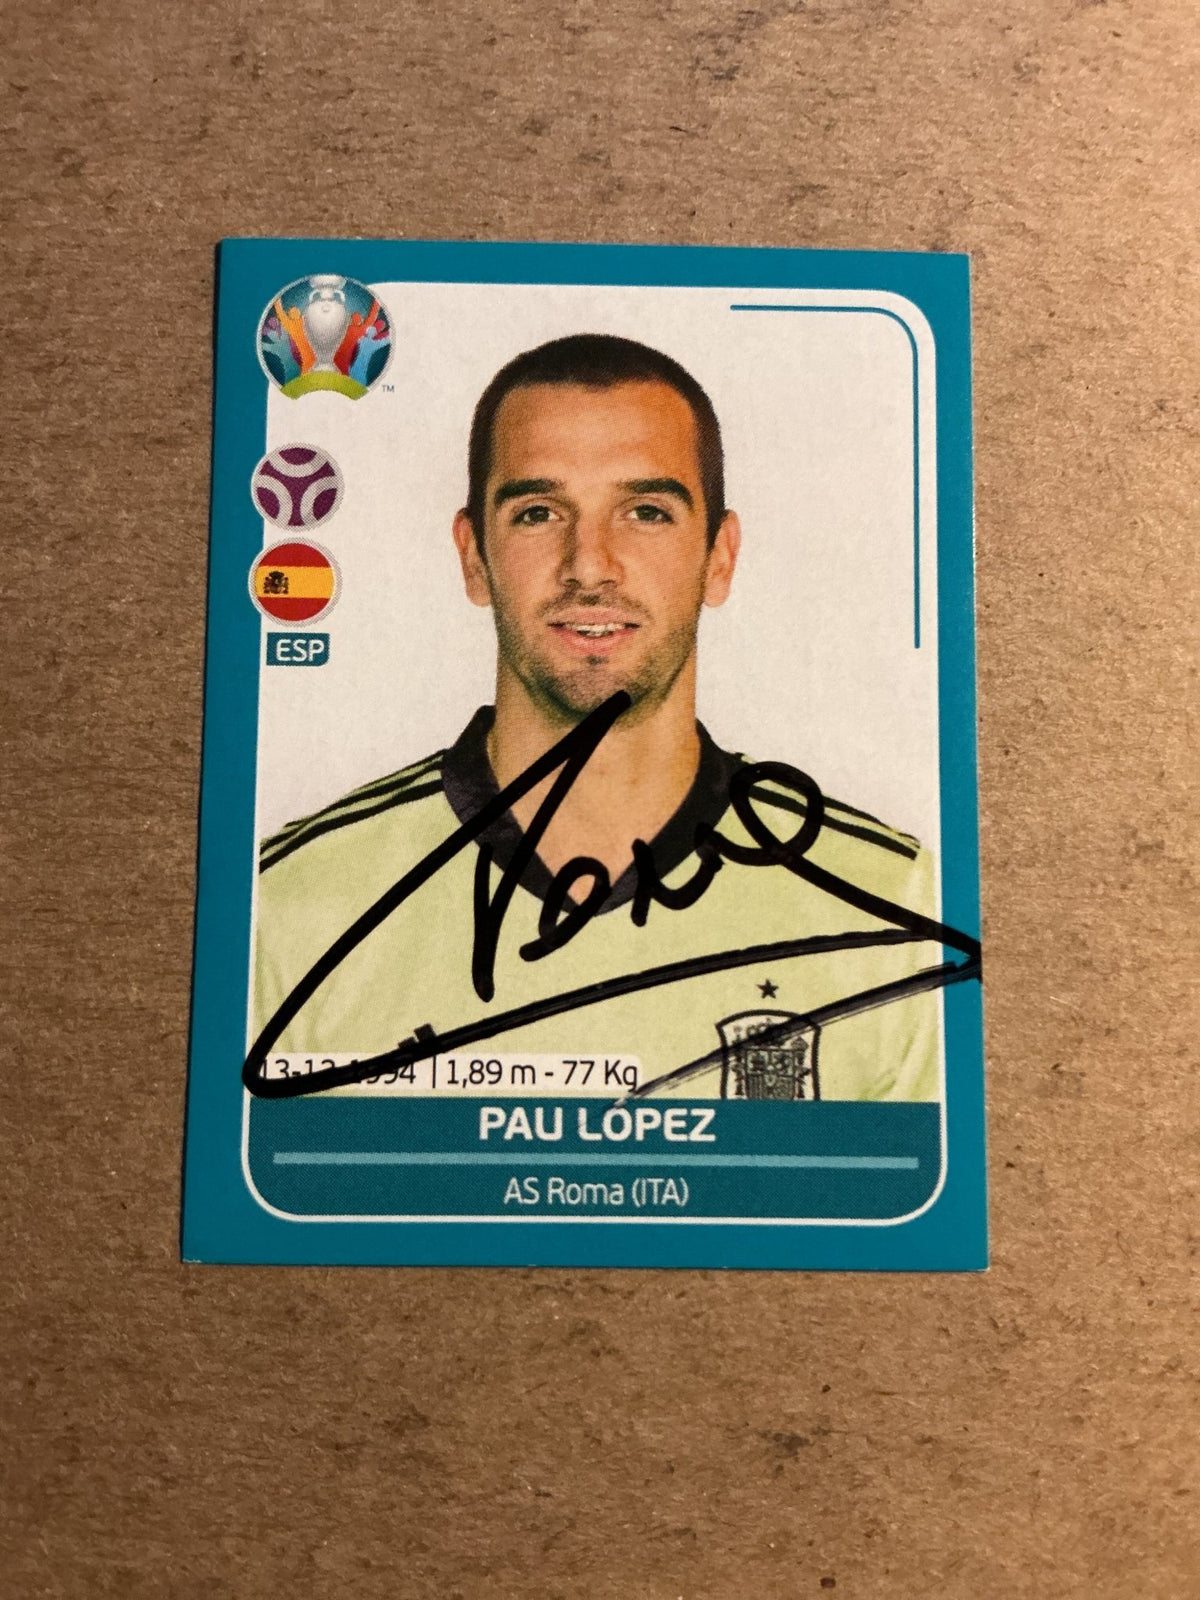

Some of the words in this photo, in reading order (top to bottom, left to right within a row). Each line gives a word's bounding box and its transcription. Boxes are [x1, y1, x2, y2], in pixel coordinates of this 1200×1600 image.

[276, 638, 325, 661] ESP
[447, 1059, 503, 1089] 1,89
[511, 1064, 536, 1085] m
[562, 1059, 595, 1085] 77
[604, 1059, 638, 1093] Kg
[479, 1106, 563, 1141] PAU
[504, 1176, 540, 1205] AS
[548, 1176, 624, 1206] Roma
[631, 1177, 689, 1208] (ITA)
